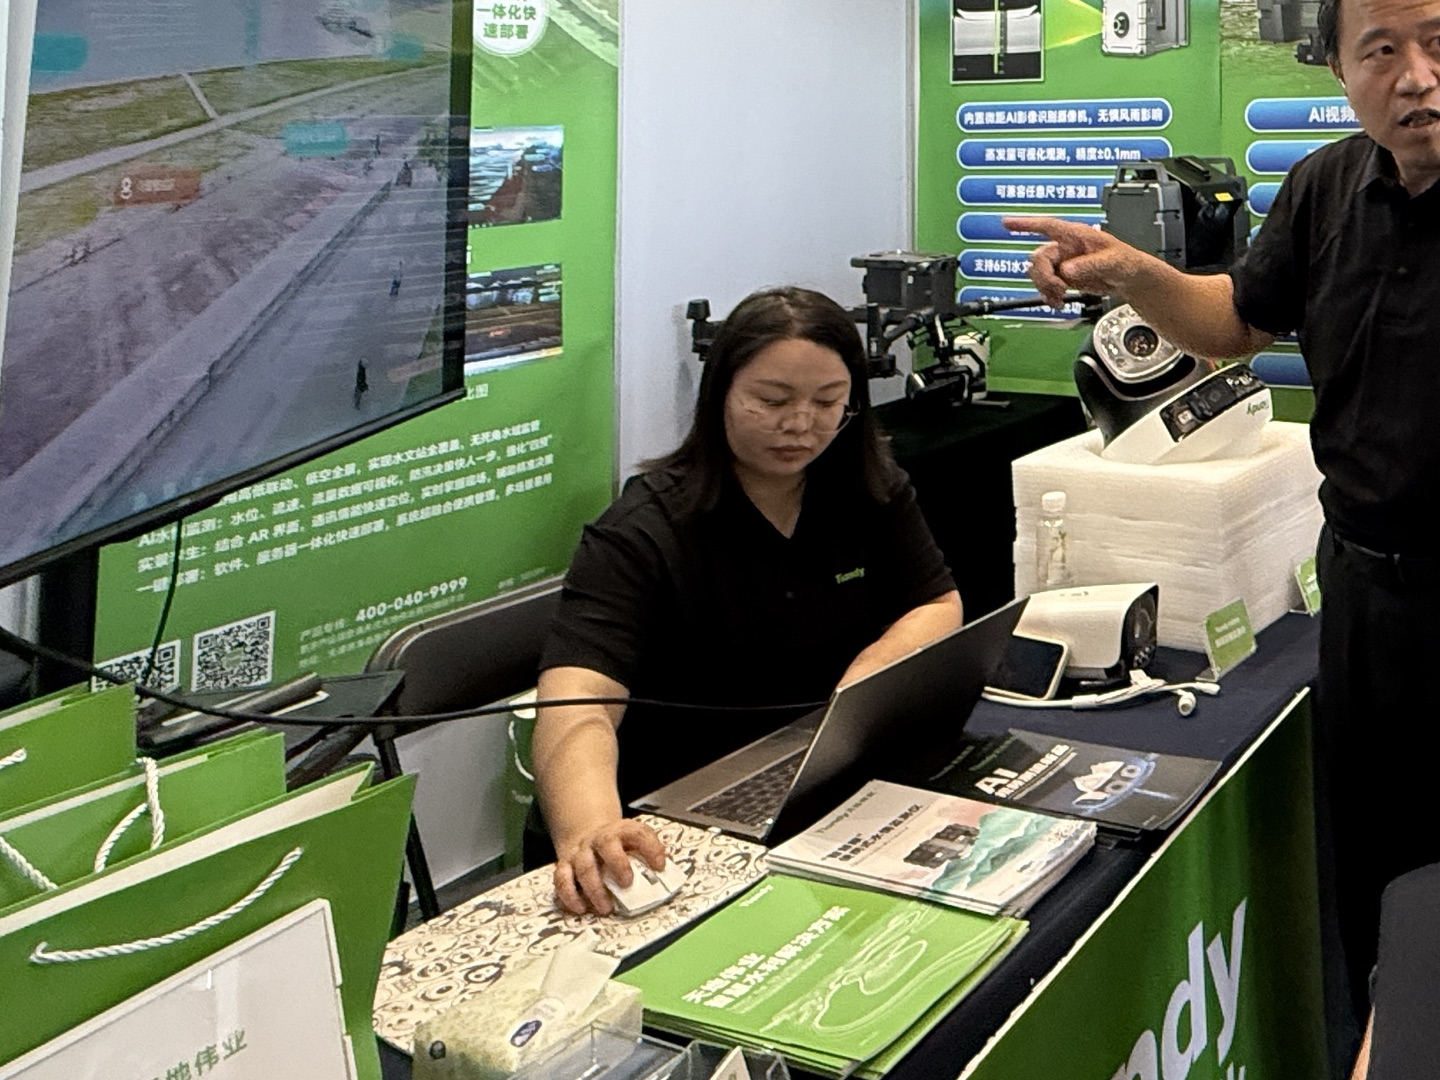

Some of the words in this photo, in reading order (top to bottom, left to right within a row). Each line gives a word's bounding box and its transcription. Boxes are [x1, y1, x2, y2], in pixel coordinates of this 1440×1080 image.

[476, 3, 537, 21] 一体化快
[483, 22, 529, 40] 速部署
[1308, 104, 1360, 123] AI视频
[249, 528, 270, 544] AR
[355, 576, 468, 622] 400-040-9999
[974, 767, 1020, 795] AI
[152, 1029, 248, 1080] 地伟业
